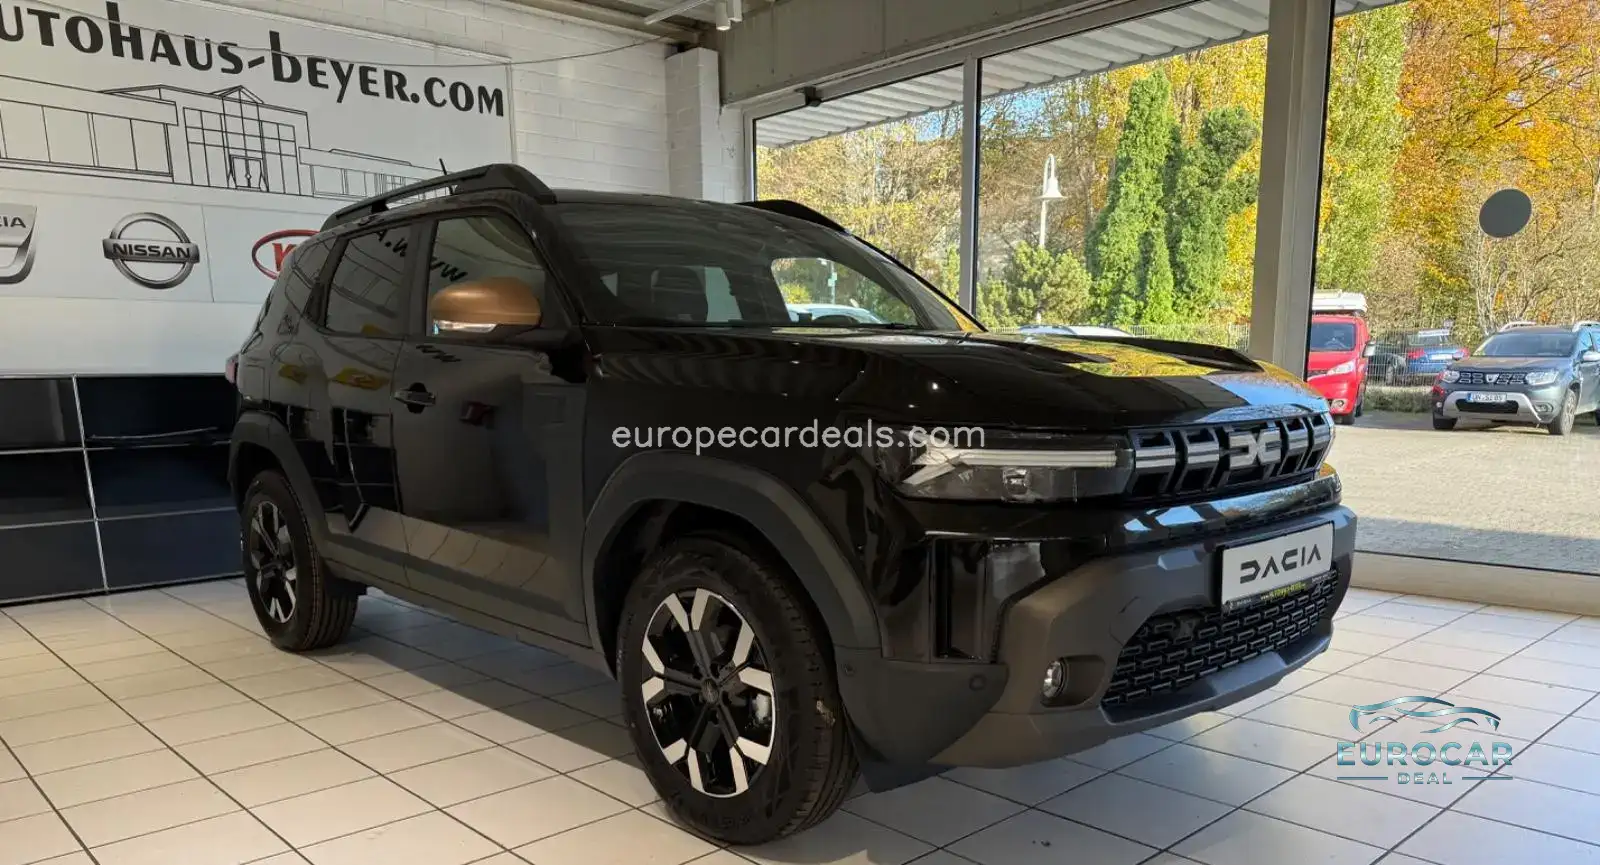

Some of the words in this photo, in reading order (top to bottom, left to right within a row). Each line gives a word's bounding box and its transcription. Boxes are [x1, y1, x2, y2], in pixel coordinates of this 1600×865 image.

[0, 215, 26, 228] IA
[112, 243, 191, 258] NISSAN
[1240, 544, 1322, 584] DACIA
